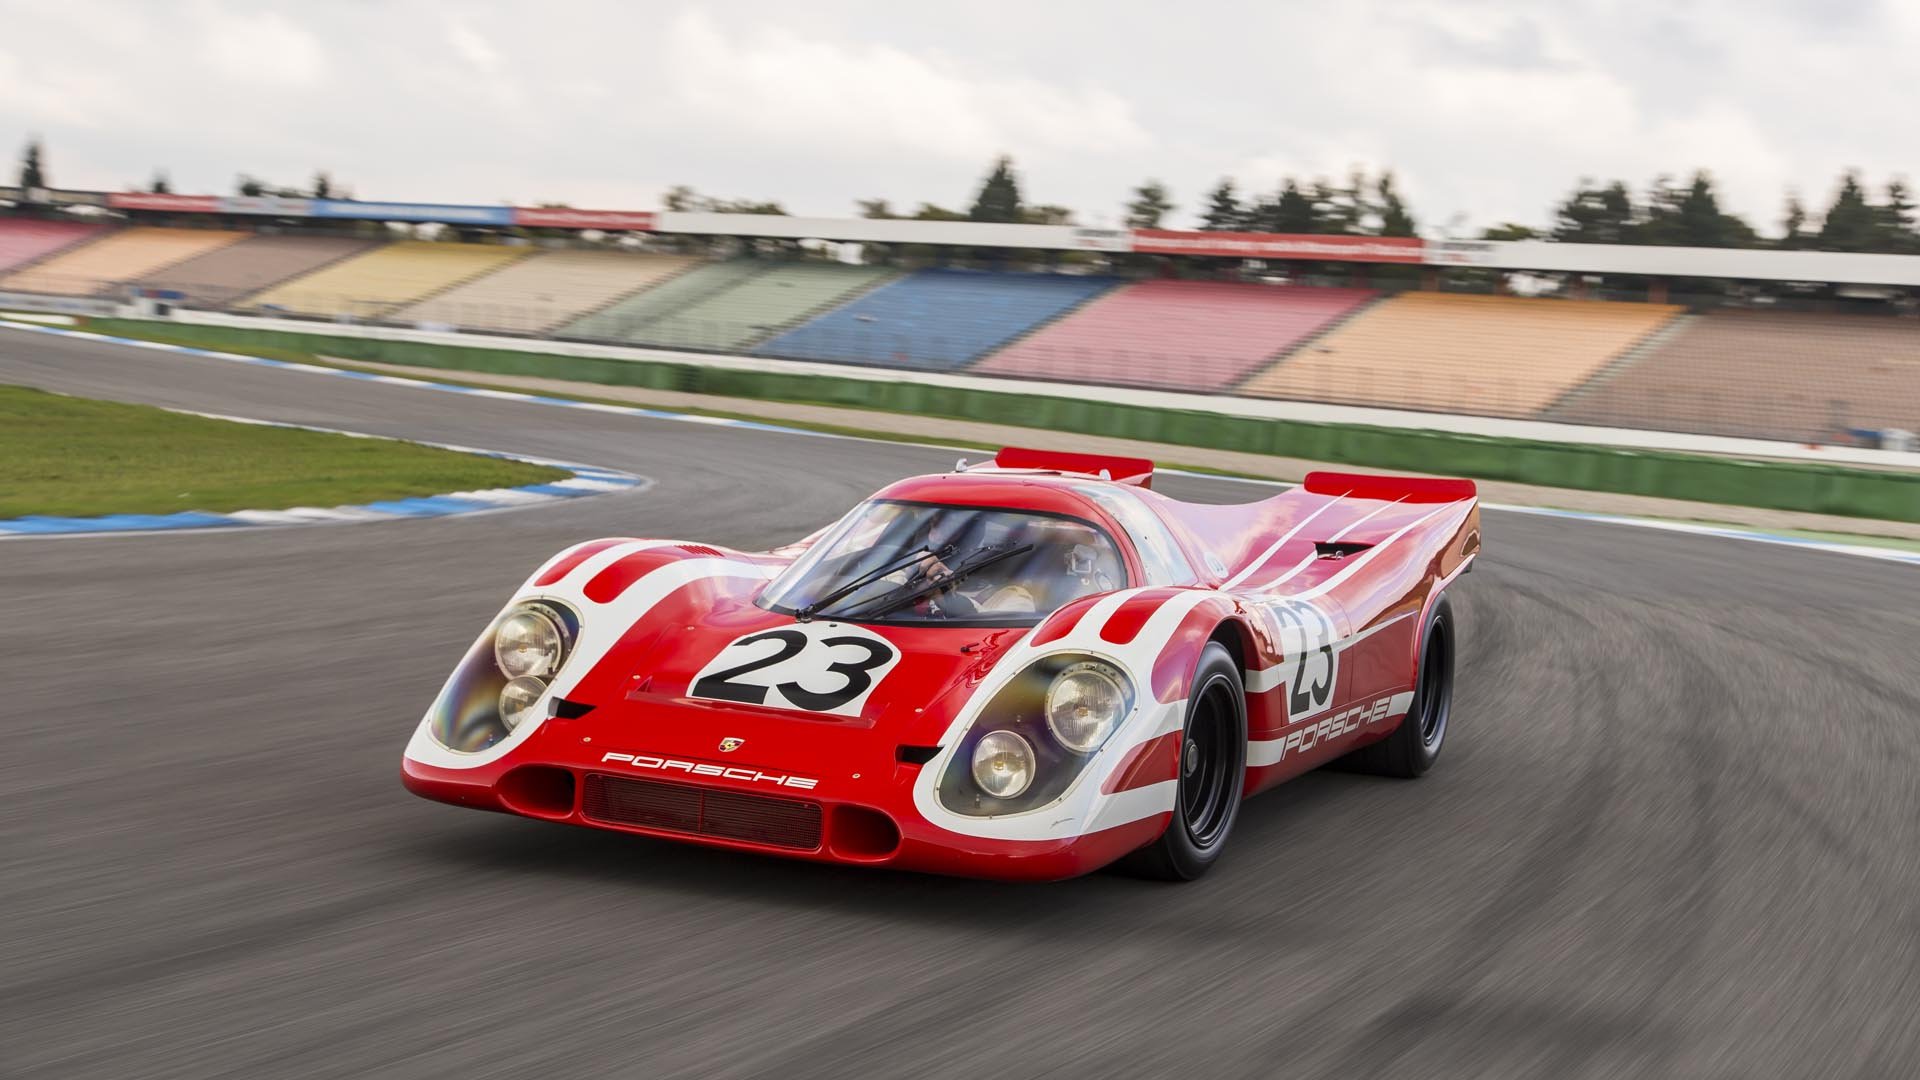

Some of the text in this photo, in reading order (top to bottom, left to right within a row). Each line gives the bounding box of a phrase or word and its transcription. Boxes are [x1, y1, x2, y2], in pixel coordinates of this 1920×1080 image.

[691, 630, 893, 711] 23
[1272, 600, 1333, 715] 23
[1282, 697, 1392, 760] PORSCHE
[601, 752, 819, 790] PORSCHE
